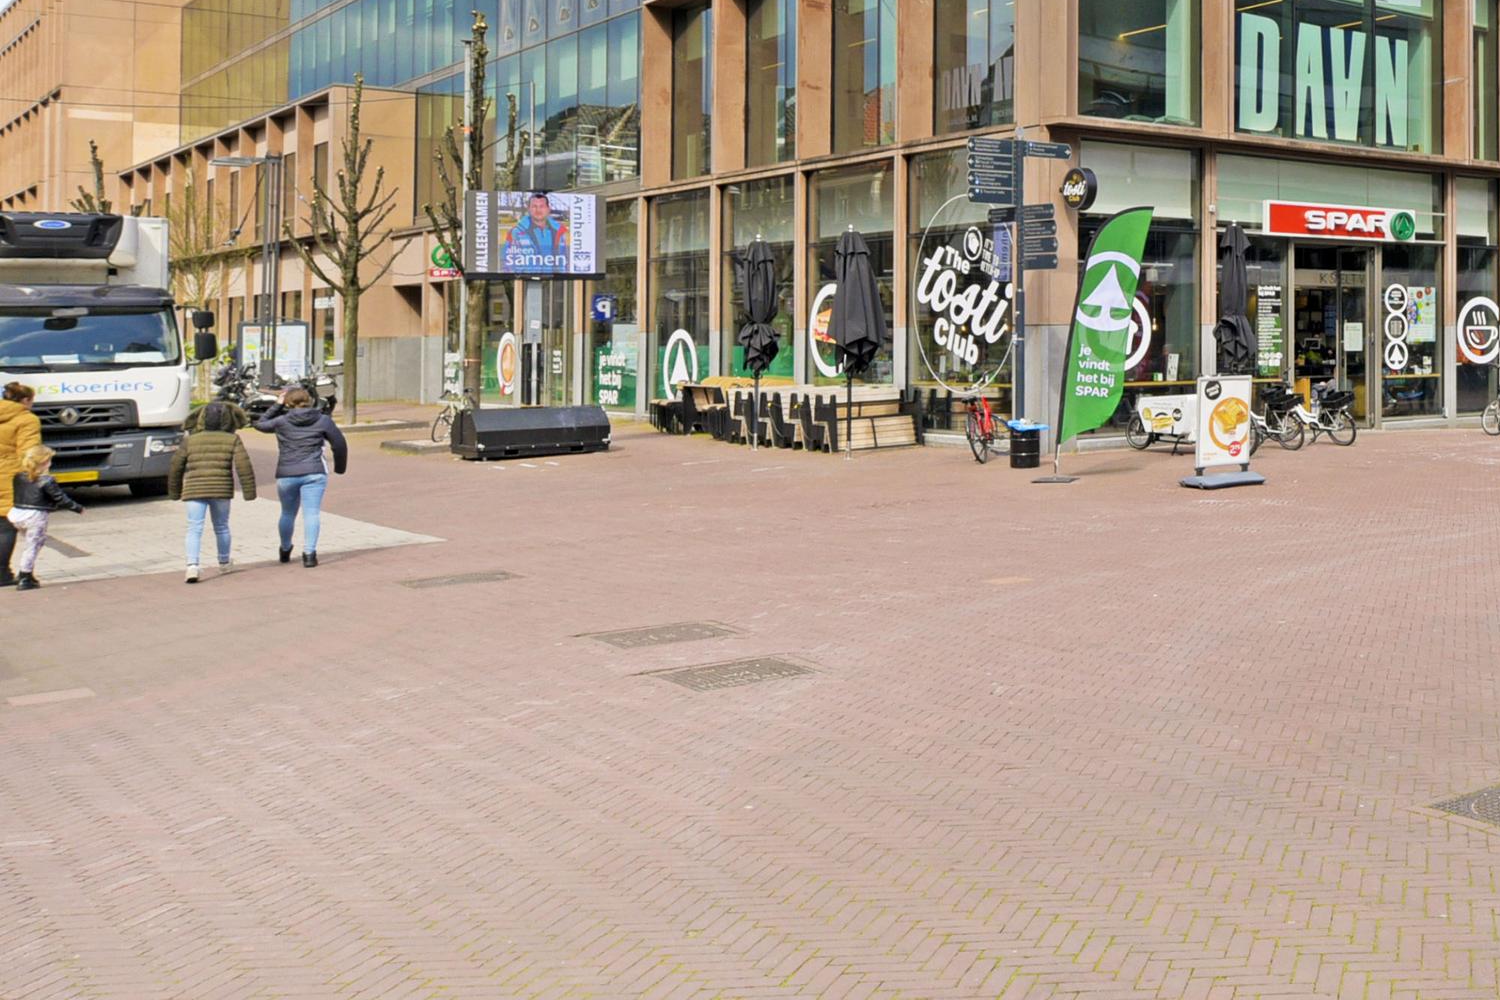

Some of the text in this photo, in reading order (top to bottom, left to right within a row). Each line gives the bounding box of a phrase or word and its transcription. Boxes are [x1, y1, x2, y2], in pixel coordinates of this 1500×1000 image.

[1063, 181, 1086, 197] tosti
[573, 196, 585, 251] Arnhem
[1304, 210, 1386, 233] SPAR
[505, 246, 535, 255] alleen
[505, 254, 567, 266] samen
[945, 245, 970, 275] The
[917, 246, 1013, 344] tosti
[934, 317, 979, 366] Club
[1078, 343, 1092, 357] je
[1078, 358, 1111, 371] vindt
[1076, 371, 1115, 388] het bij
[599, 390, 619, 405] SPAR
[1075, 385, 1109, 398] SPAR
